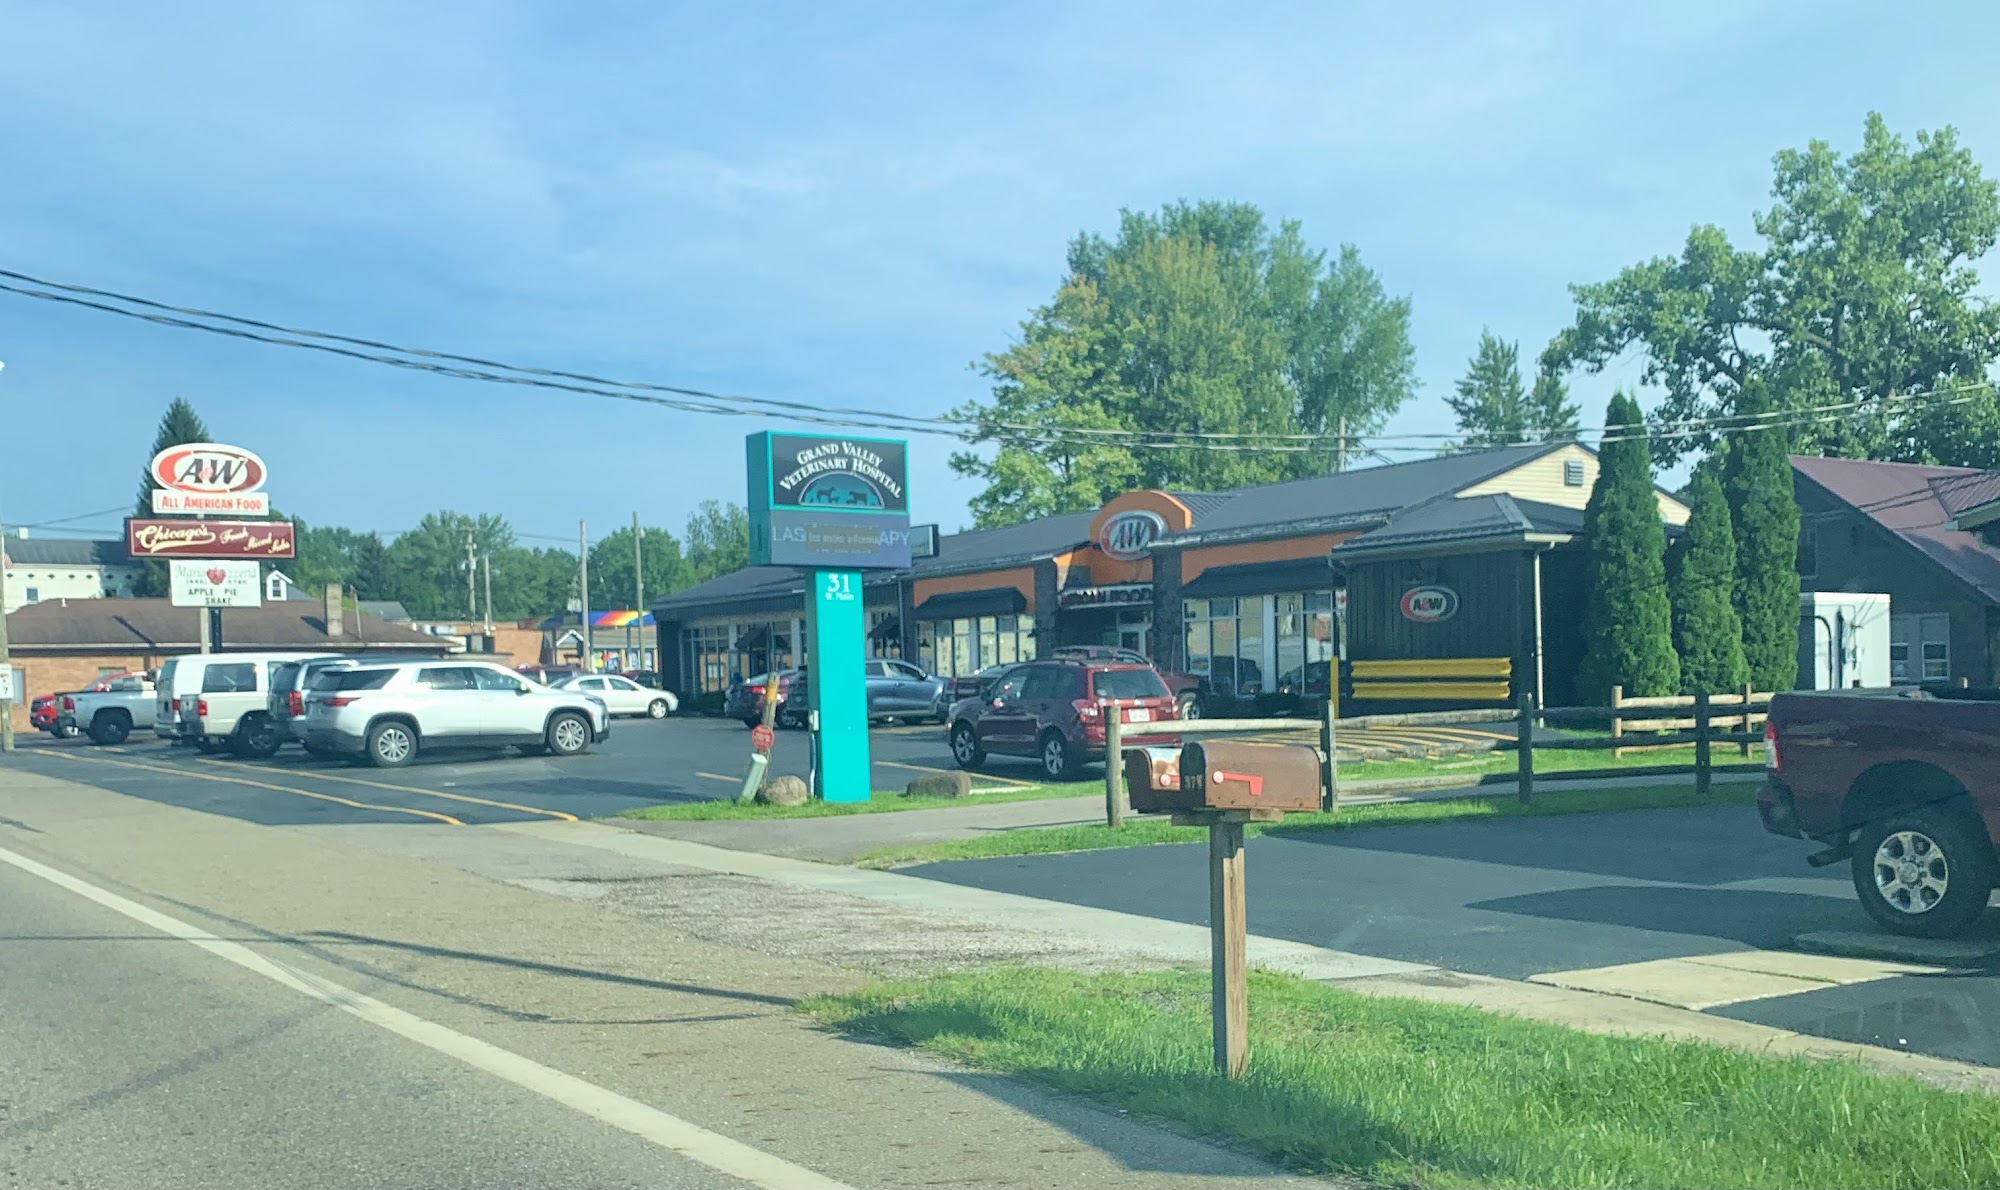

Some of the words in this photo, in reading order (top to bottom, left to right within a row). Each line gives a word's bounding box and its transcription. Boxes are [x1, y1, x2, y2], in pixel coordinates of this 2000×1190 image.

[797, 442, 839, 465] GRAND
[842, 441, 883, 467] VALLEY
[177, 458, 246, 485] A&W
[779, 458, 848, 491] VETERINARY
[852, 459, 902, 498] HOSPITAL
[161, 495, 179, 508] ALL
[184, 496, 233, 510] AMERICAN
[237, 498, 262, 510] FOOD
[136, 524, 214, 551] Chicago's
[771, 526, 807, 542] LAS
[879, 529, 911, 546] APY
[1112, 521, 1149, 549] A&W
[188, 588, 213, 596] APPLE
[224, 588, 237, 596] PIE
[827, 573, 849, 592] 31
[205, 597, 232, 606] SHAKE
[836, 593, 854, 601] Main
[1413, 597, 1444, 611] A&W
